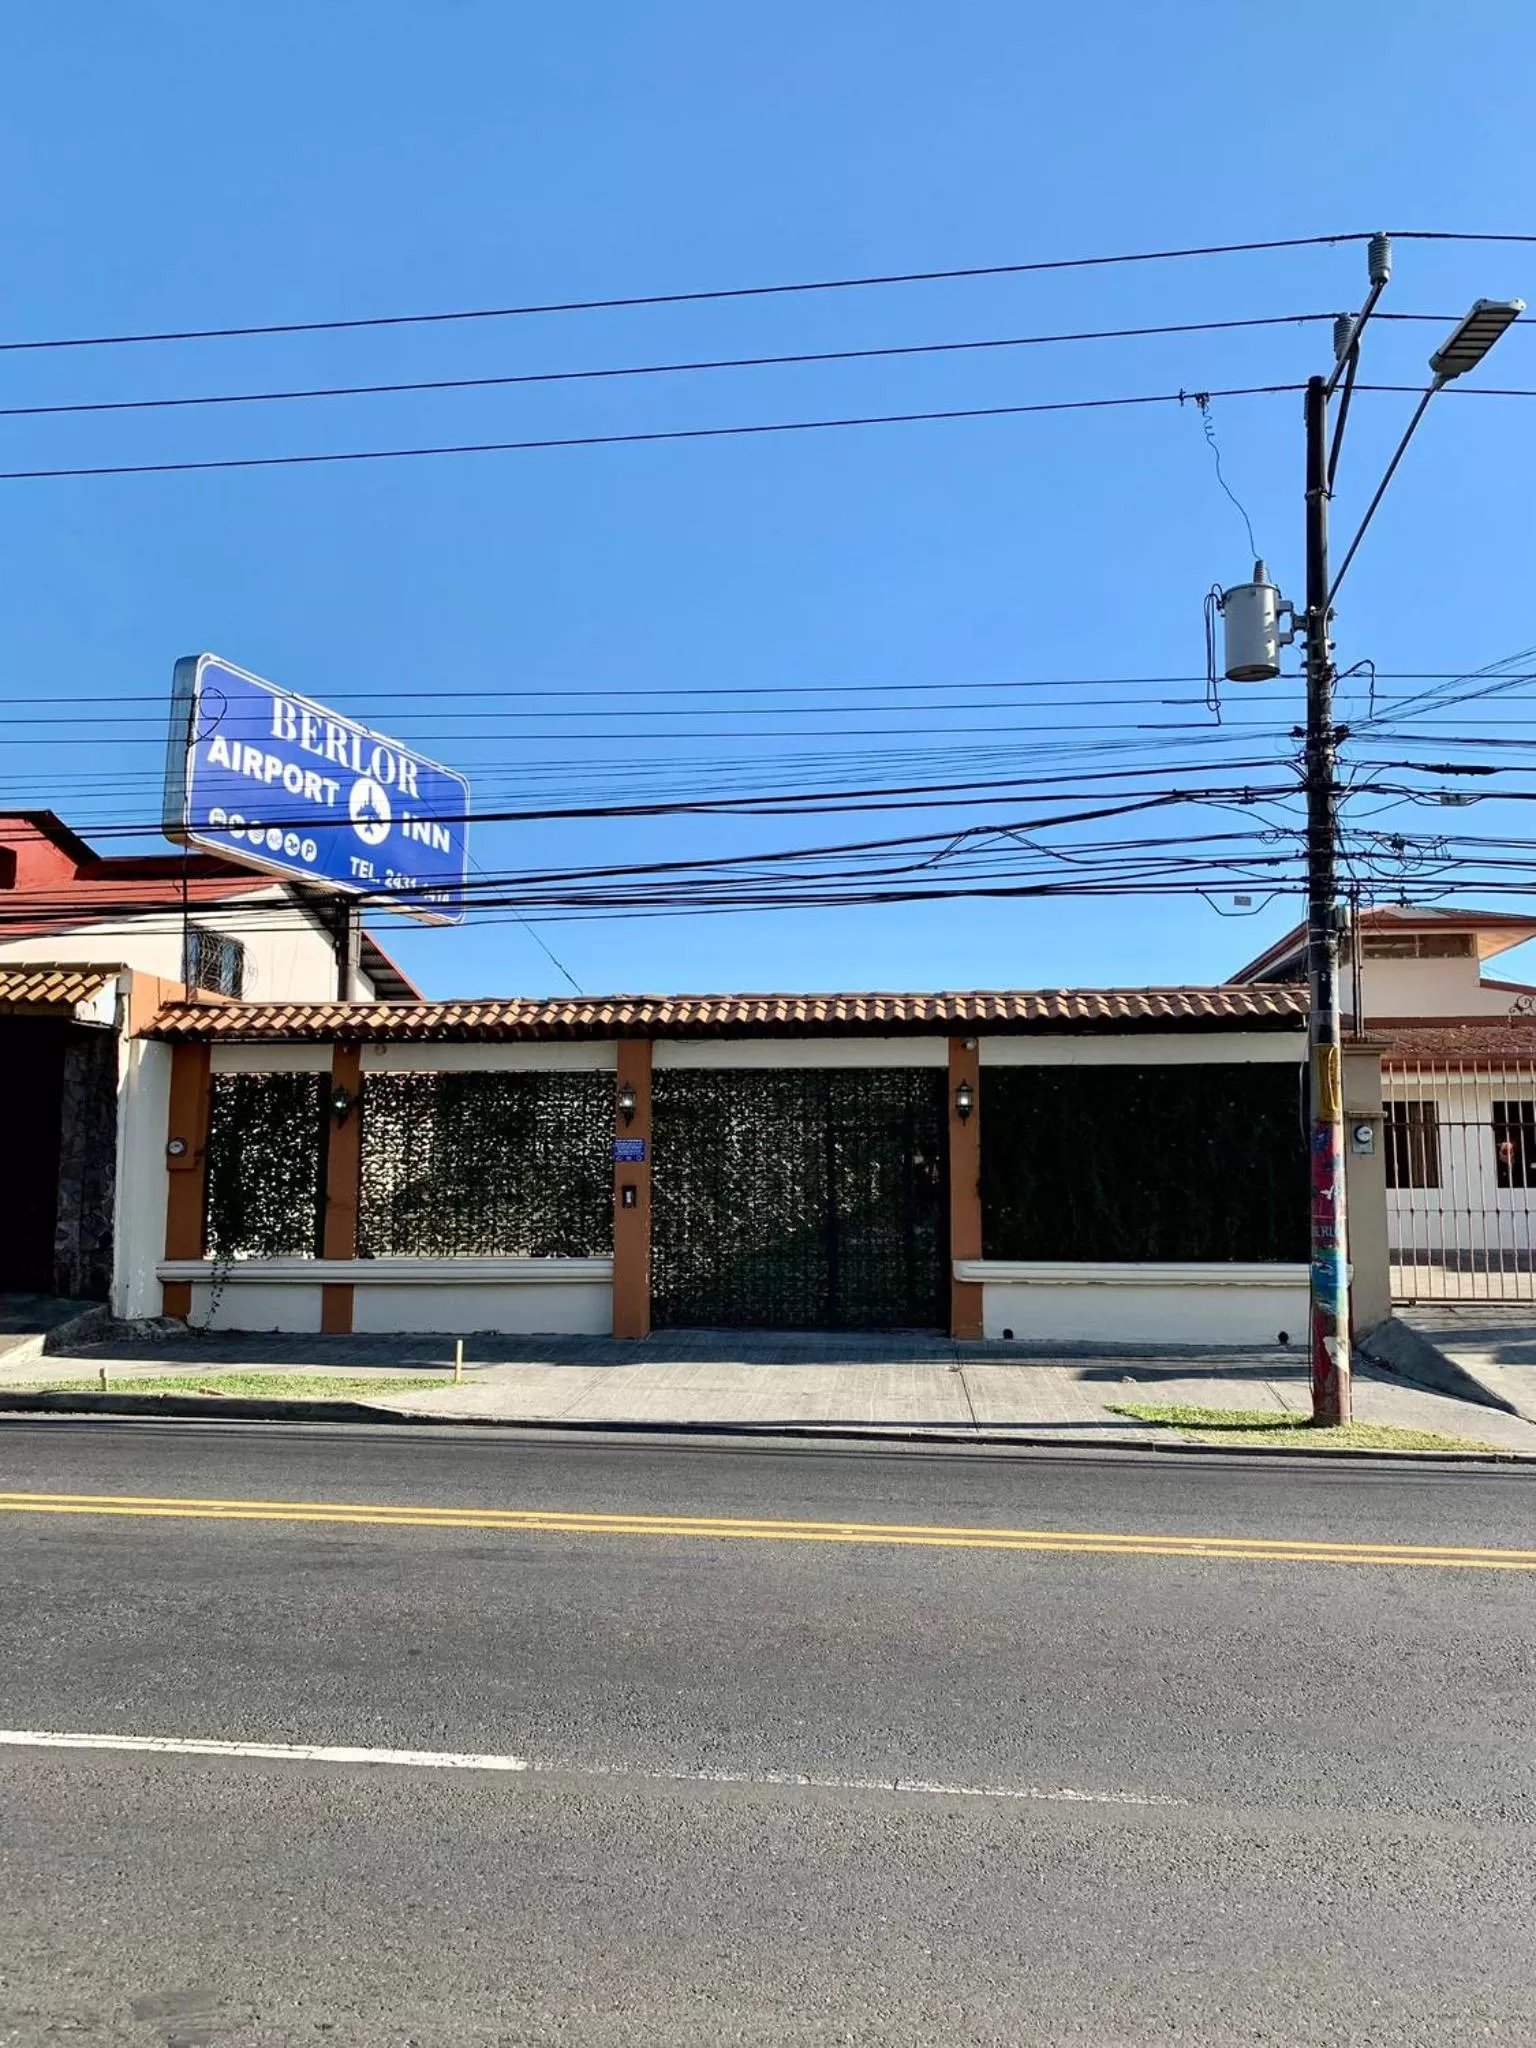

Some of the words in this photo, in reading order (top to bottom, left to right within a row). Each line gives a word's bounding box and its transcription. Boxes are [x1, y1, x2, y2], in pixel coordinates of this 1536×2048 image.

[207, 735, 340, 808] AIRPORT
[271, 697, 420, 799] BERLOR
[402, 811, 450, 853] INN
